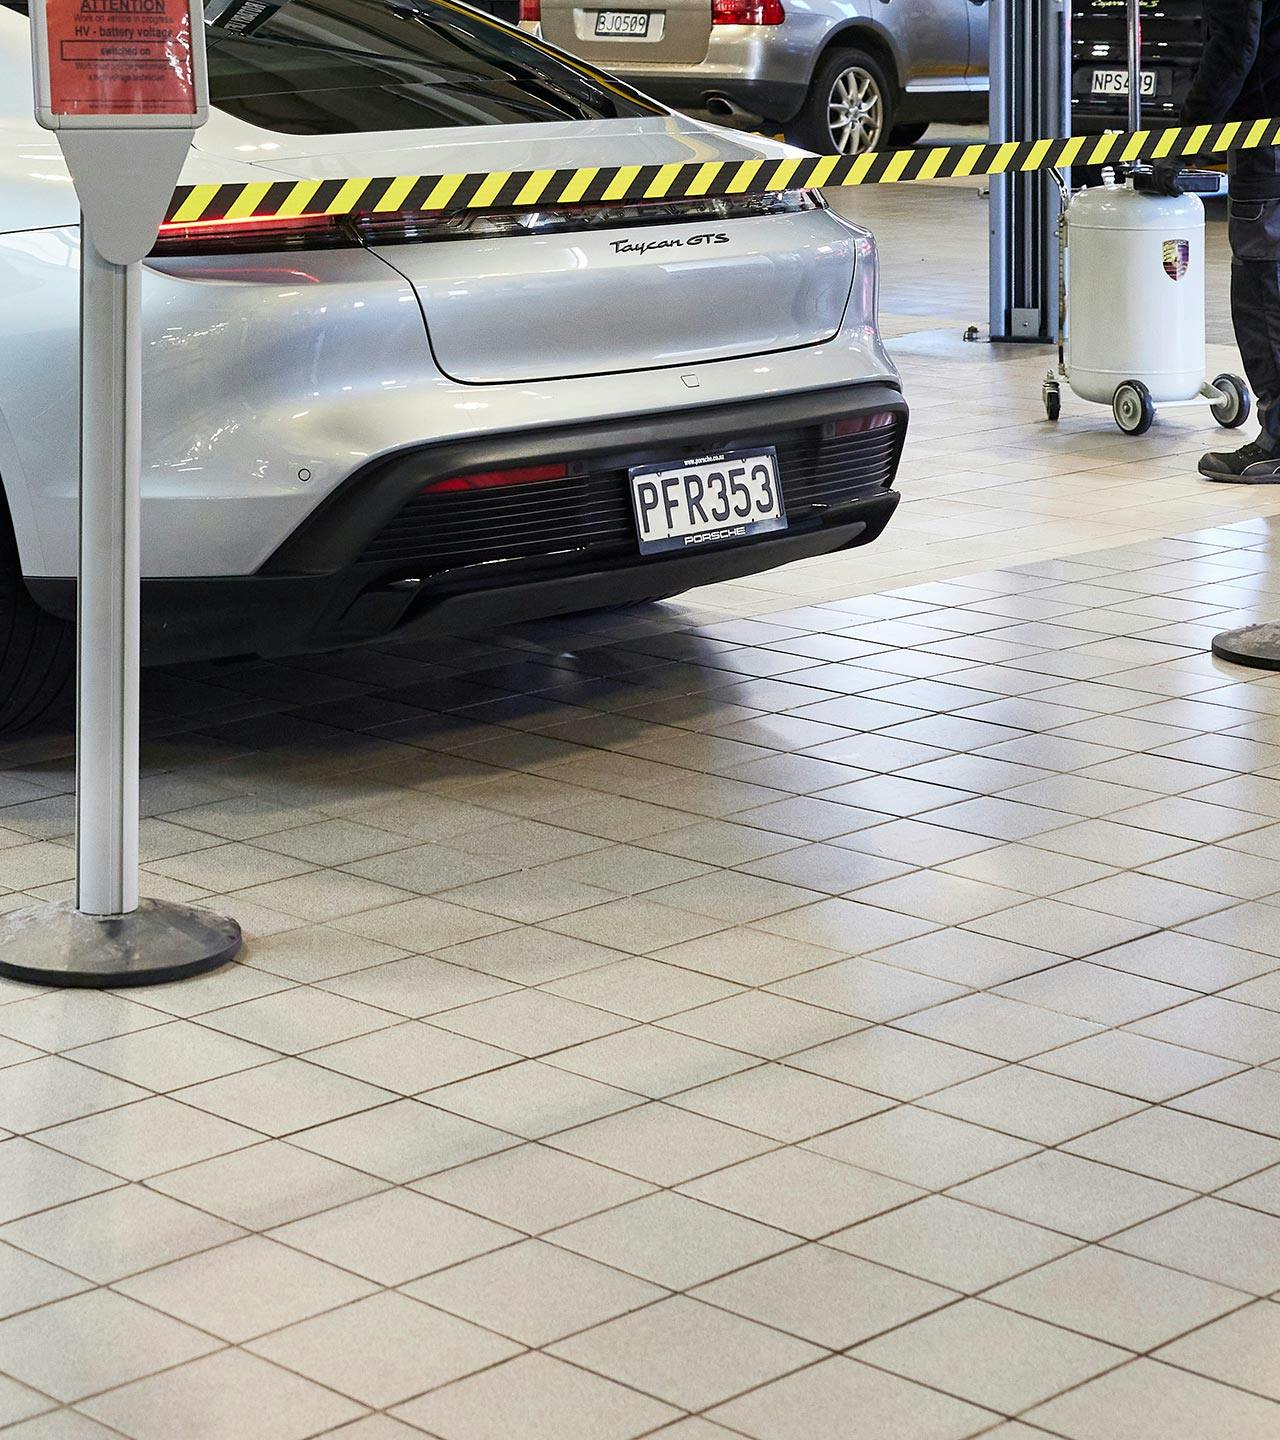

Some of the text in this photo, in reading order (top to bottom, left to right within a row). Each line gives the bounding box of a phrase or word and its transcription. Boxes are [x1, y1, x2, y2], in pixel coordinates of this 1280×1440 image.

[81, 0, 165, 12] ATTENTION
[75, 27, 90, 36] HV
[100, 26, 134, 39] battery
[137, 27, 172, 40] voltage
[140, 48, 151, 56] on
[1094, 73, 1153, 92] NPS49
[609, 233, 730, 255] Taycan GTS
[637, 464, 774, 534] PFR353
[683, 526, 746, 545] PORSCHE
